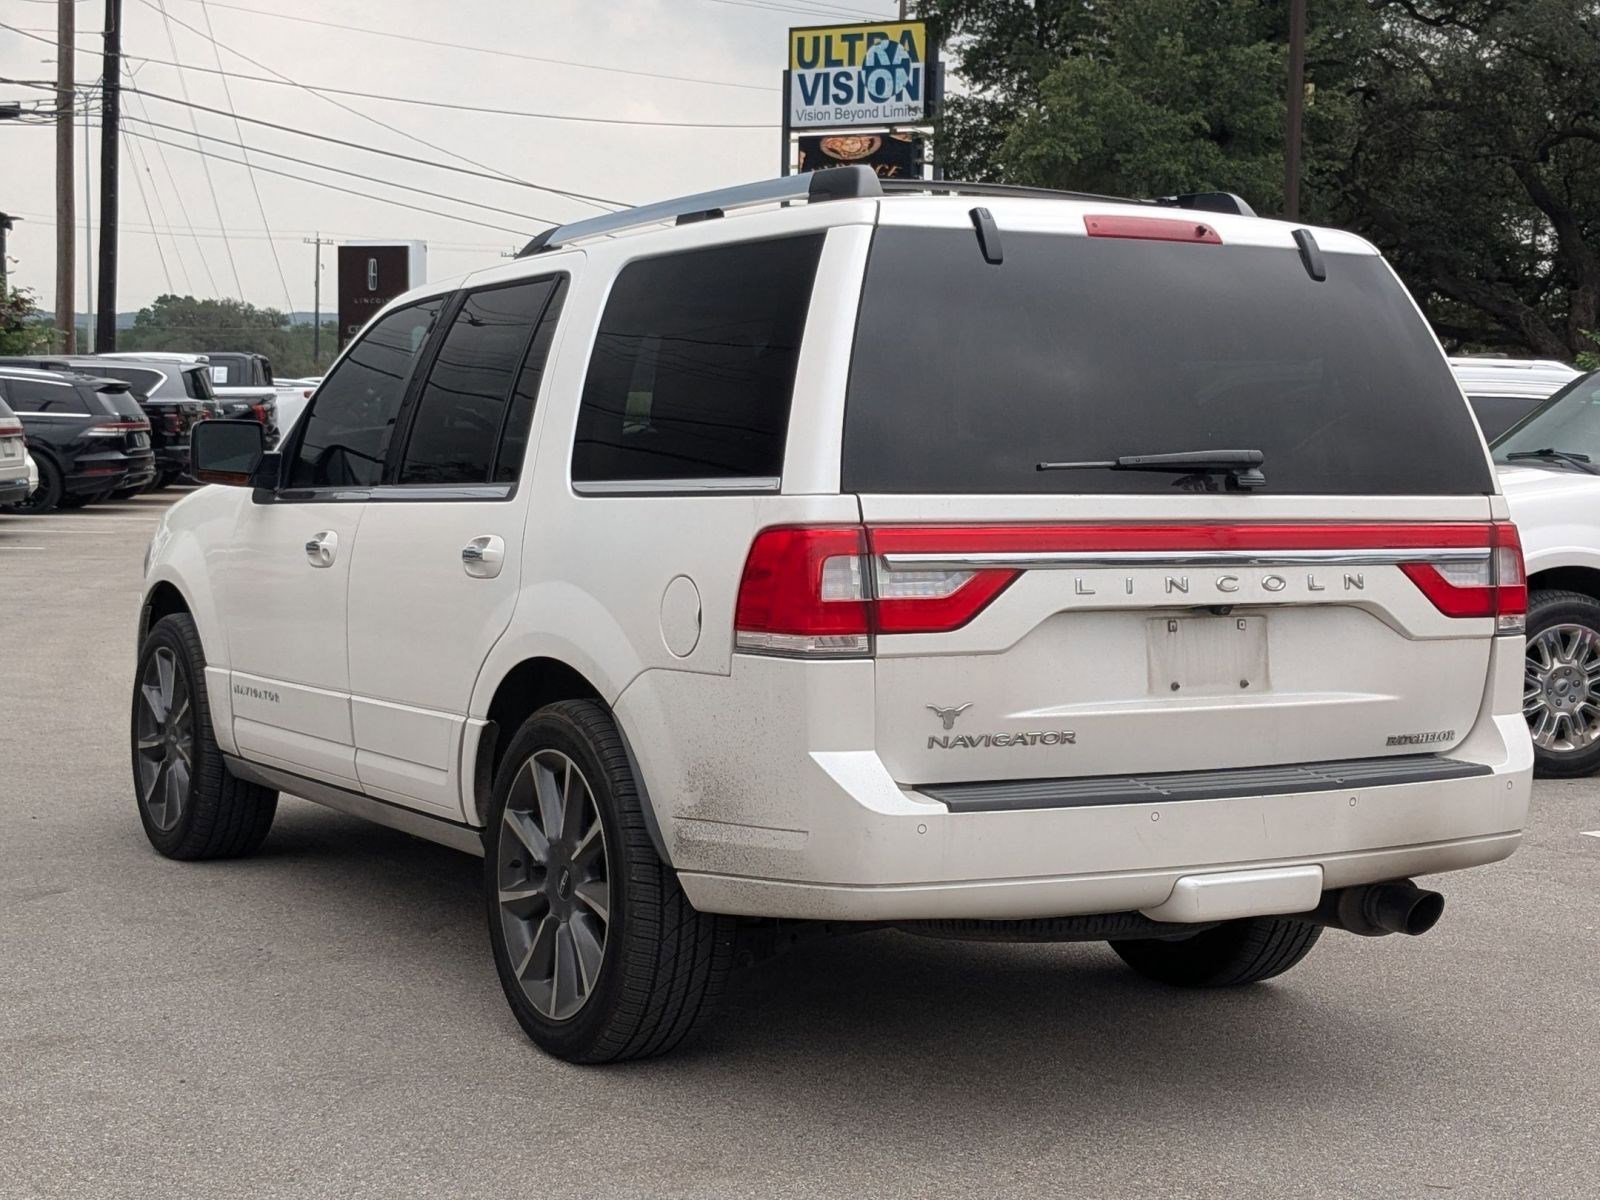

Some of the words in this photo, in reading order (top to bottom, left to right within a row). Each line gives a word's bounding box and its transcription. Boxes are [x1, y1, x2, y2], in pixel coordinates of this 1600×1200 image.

[797, 30, 920, 70] ULTRA
[798, 67, 920, 107] VISION
[796, 109, 831, 122] Vision
[835, 106, 879, 122] Beyond
[883, 104, 917, 119] Limits
[1075, 573, 1365, 595] LINCOLN
[927, 731, 1077, 749] NAVIGATOR
